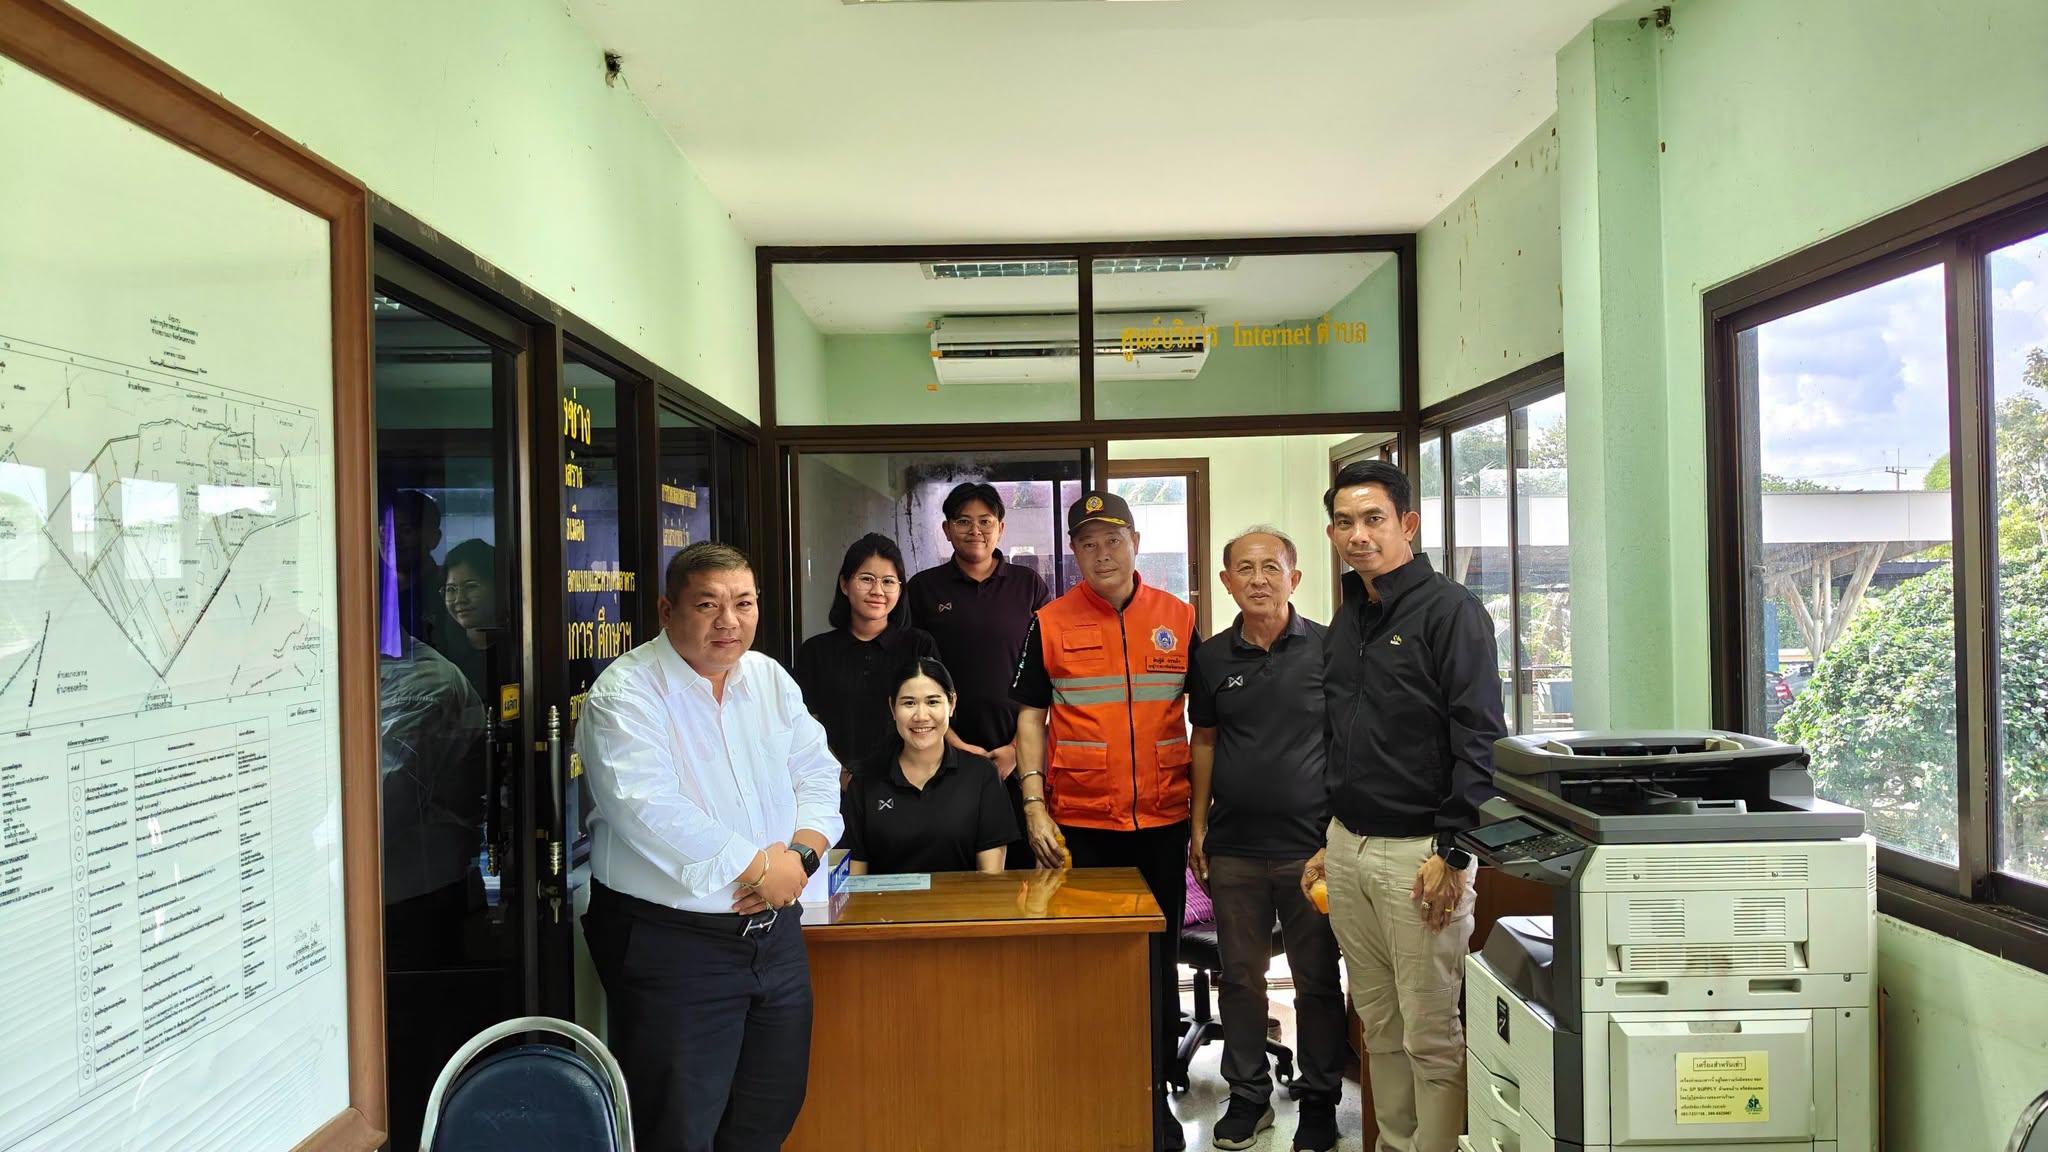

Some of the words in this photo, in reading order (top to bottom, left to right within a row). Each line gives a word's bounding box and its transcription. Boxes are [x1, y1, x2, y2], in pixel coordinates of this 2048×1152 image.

[1120, 316, 1218, 363] ศูนย์บริการ
[1232, 320, 1312, 348] Internet
[1316, 313, 1368, 345] ตำบล
[1748, 1098, 1760, 1109] SP
